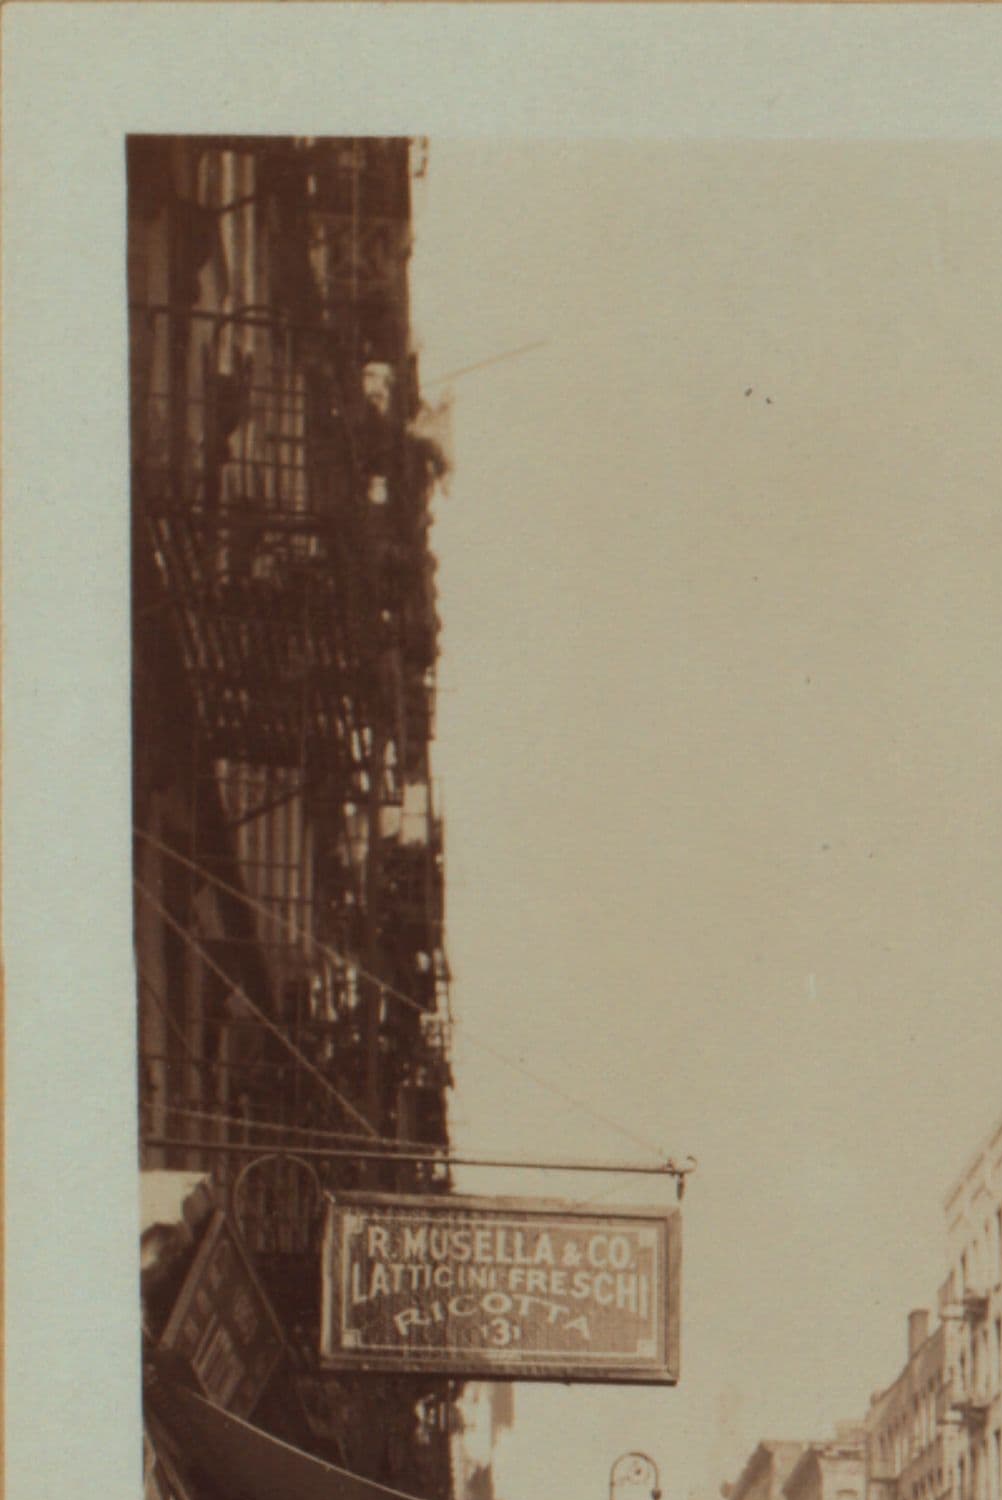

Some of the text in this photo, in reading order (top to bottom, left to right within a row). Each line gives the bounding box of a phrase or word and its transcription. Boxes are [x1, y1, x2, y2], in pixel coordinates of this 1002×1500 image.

[562, 1240, 582, 1266] &
[589, 1234, 637, 1270] CO.
[352, 1262, 649, 1320] LATTICINI FRESCHI
[393, 1292, 592, 1340] RICOTTA
